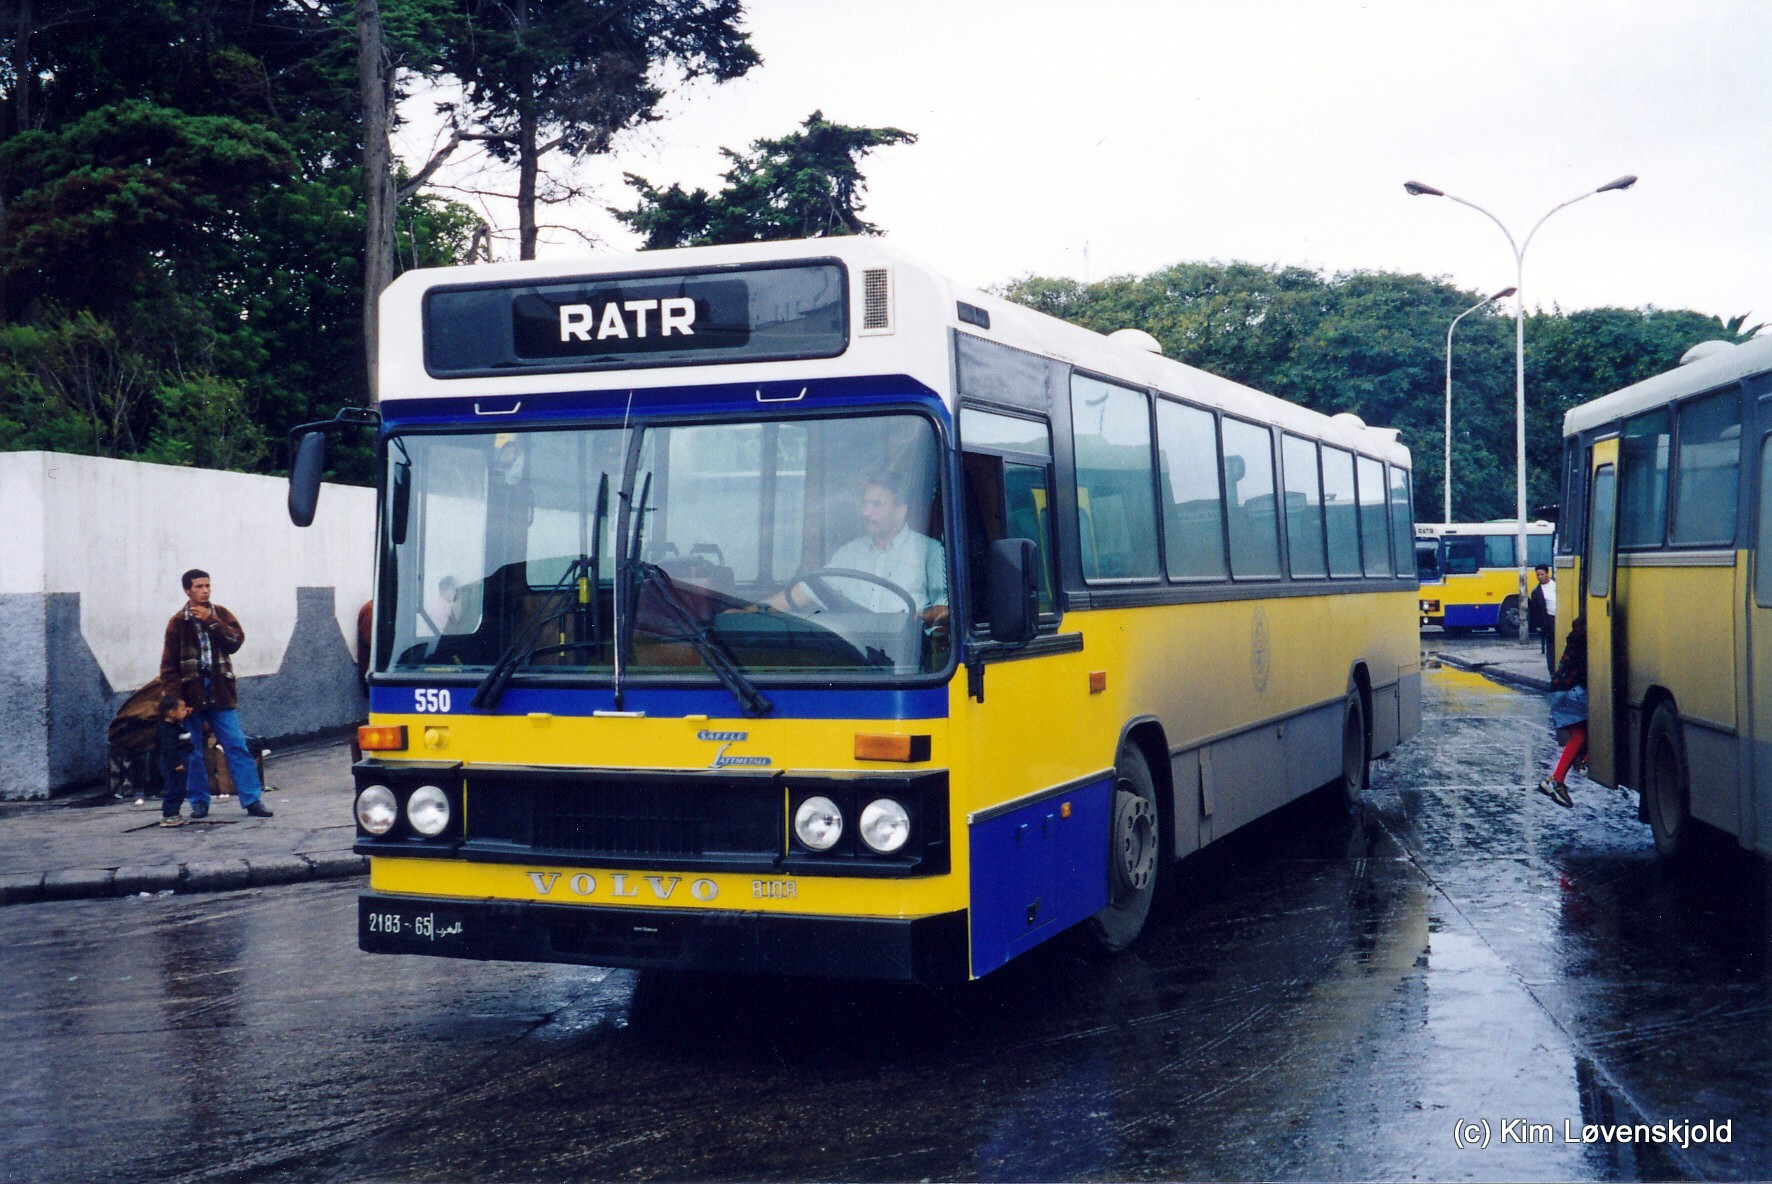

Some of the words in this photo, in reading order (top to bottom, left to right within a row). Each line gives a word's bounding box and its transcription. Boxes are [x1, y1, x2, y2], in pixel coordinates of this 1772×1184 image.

[559, 297, 696, 342] RATR
[414, 688, 451, 713] 550
[526, 871, 718, 901] VOLVO
[369, 912, 401, 933] 2183
